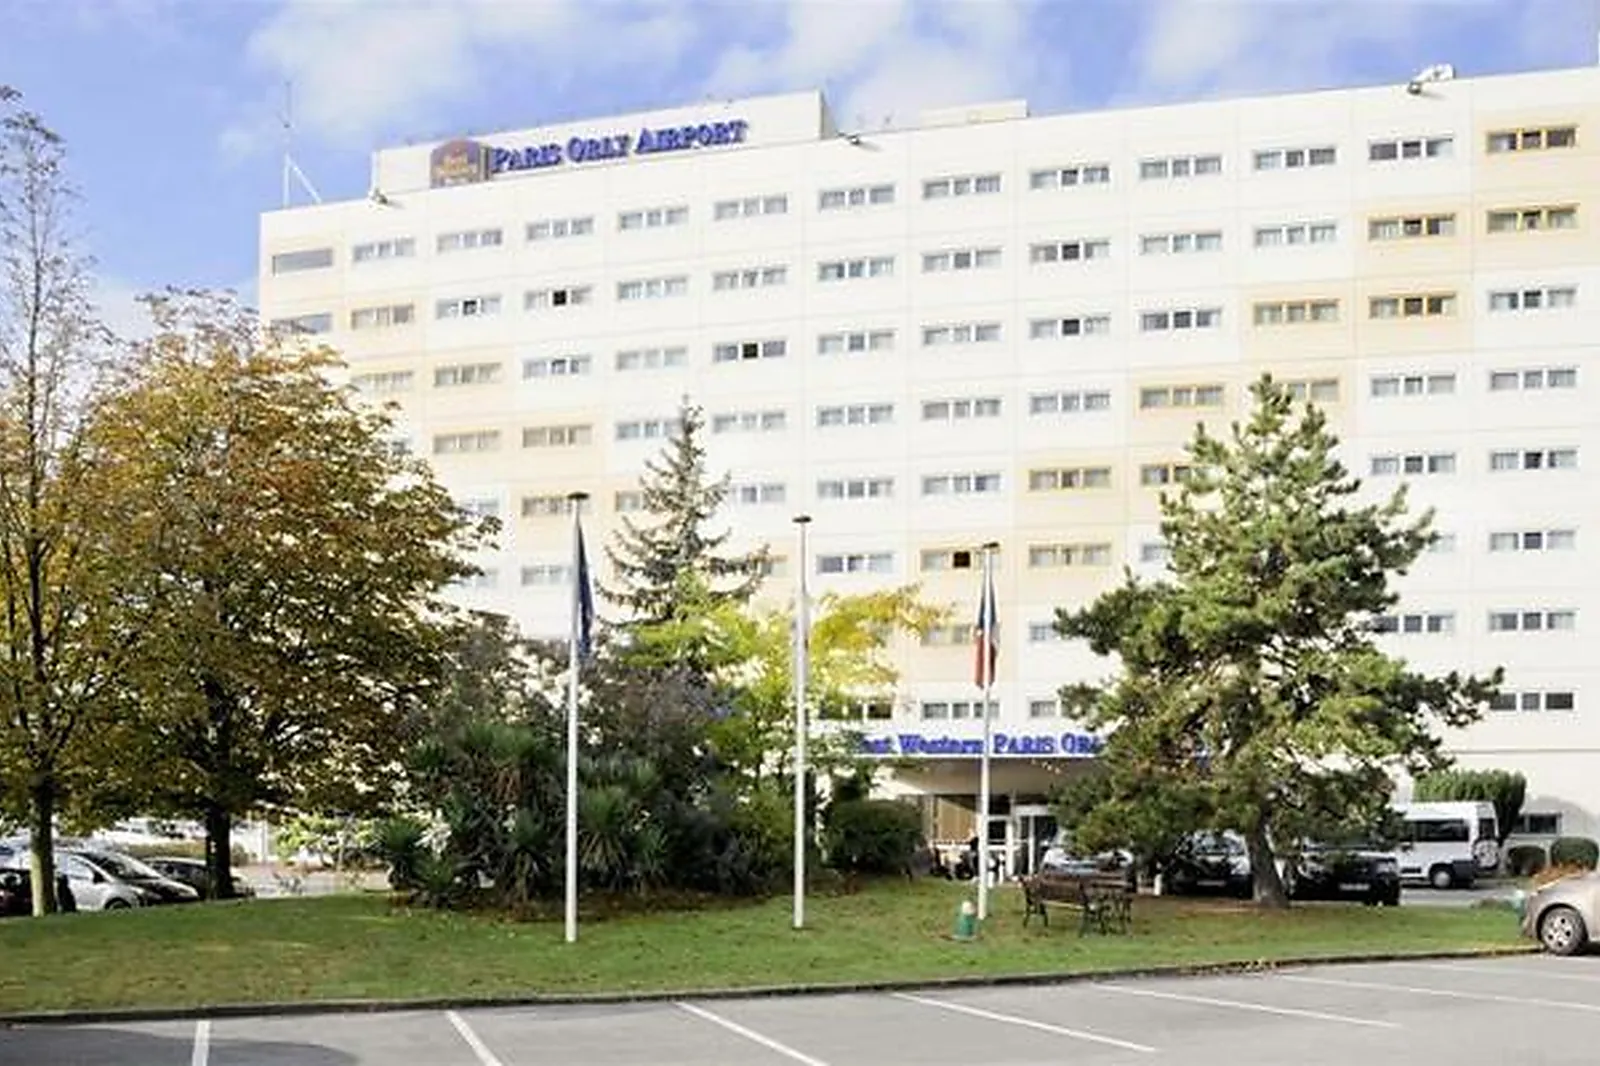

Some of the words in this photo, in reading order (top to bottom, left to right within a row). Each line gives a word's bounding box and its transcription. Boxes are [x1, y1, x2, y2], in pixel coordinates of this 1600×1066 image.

[491, 144, 562, 173] PARIS
[567, 135, 631, 162] ORLY
[634, 119, 749, 154] AIRPORT
[993, 732, 1055, 754] PARIS
